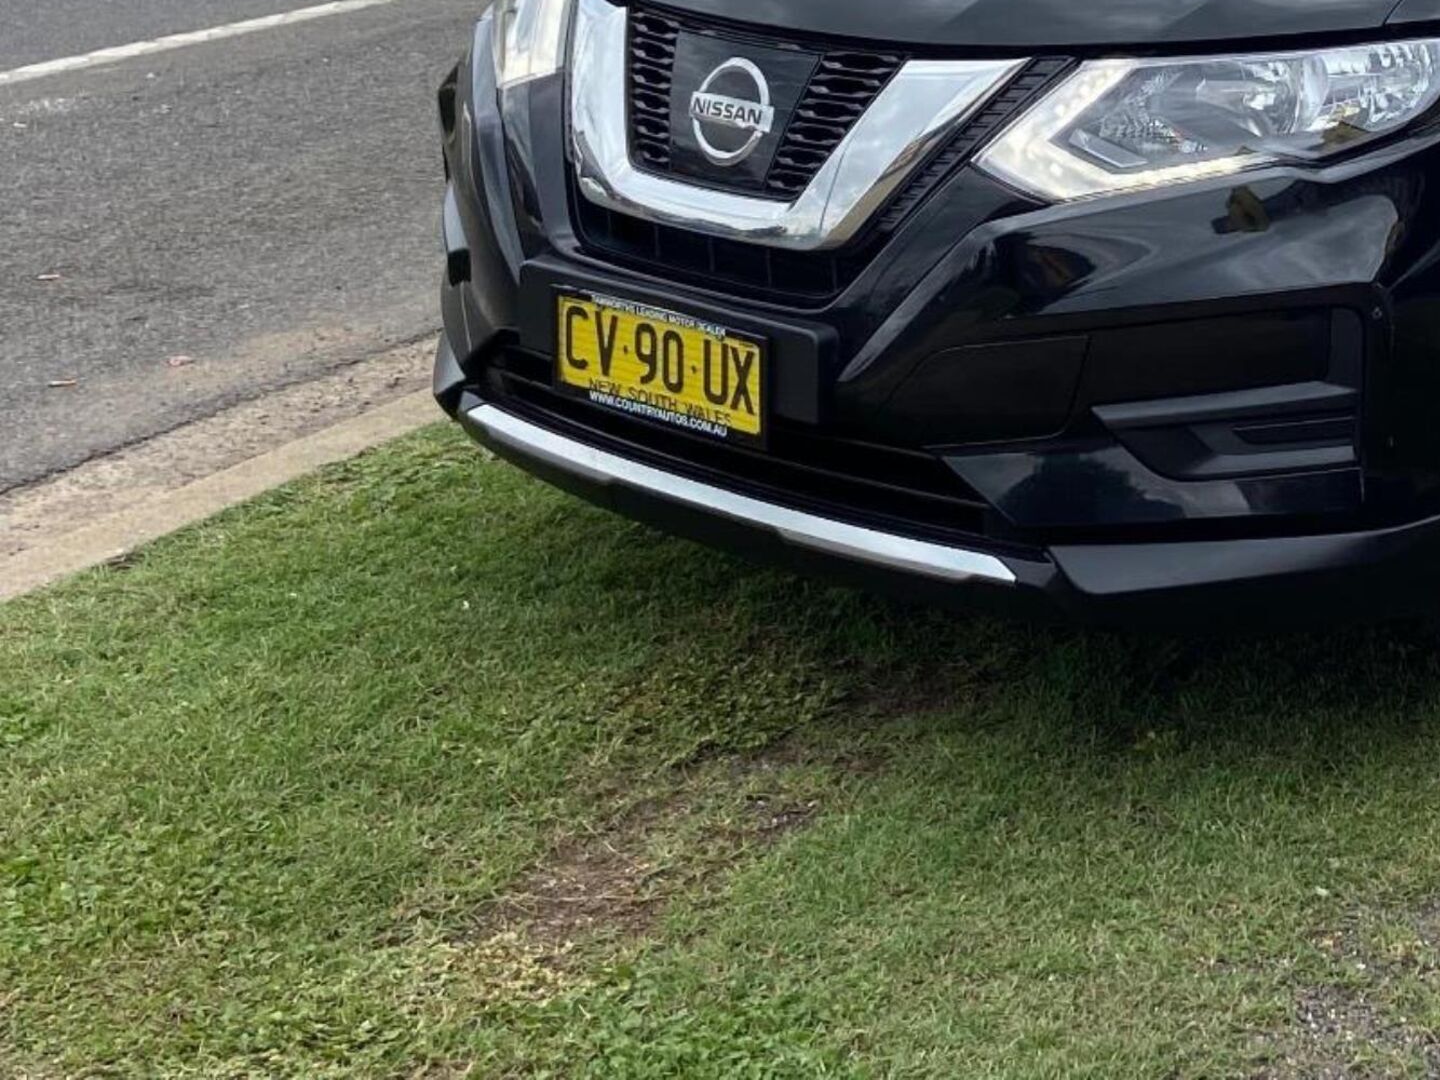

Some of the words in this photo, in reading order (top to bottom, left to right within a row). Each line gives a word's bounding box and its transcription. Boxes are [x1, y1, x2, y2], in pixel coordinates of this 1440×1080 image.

[692, 97, 763, 125] NISSAN
[589, 378, 621, 396] NEW
[628, 386, 677, 411] SOUTH
[681, 399, 732, 425] WALES
